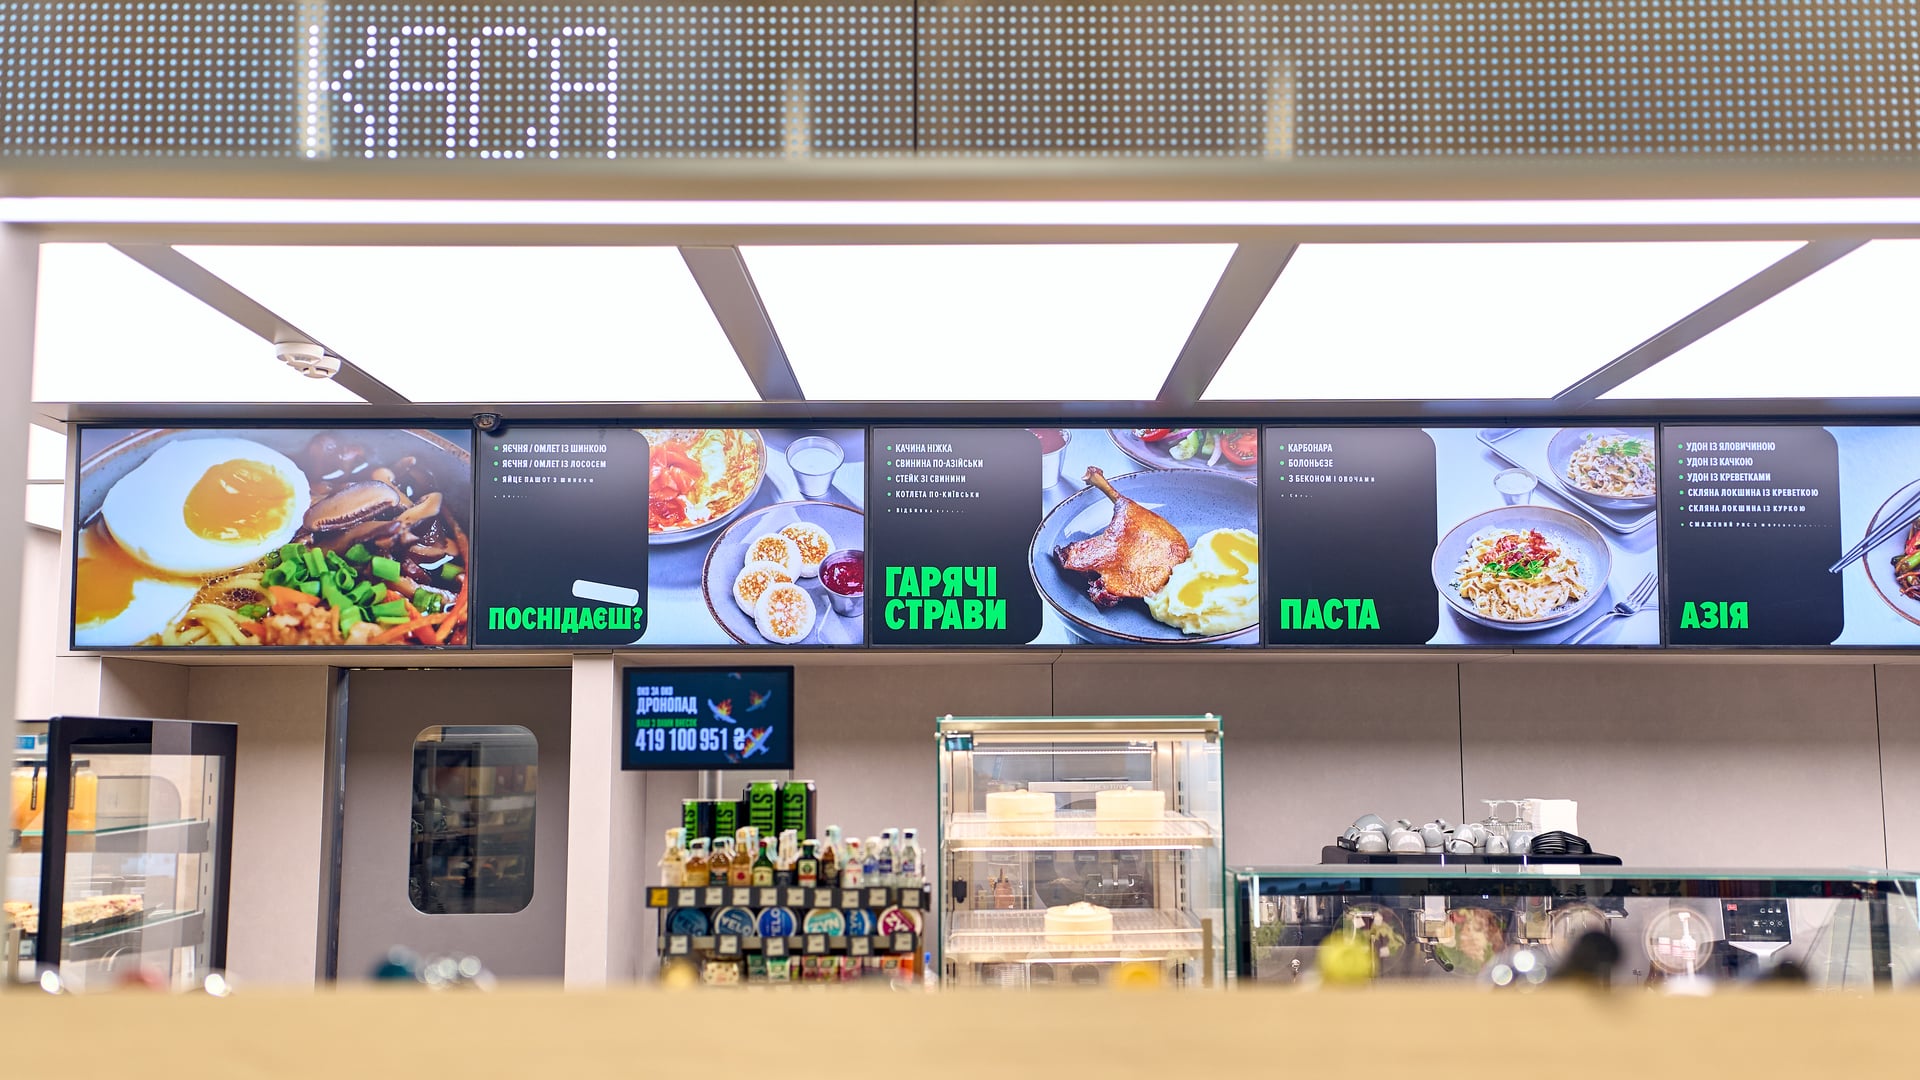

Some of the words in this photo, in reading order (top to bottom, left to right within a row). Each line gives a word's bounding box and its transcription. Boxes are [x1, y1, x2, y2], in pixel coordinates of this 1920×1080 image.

[306, 25, 617, 159] КАСА
[502, 444, 528, 453] ЯЄЧНЯ
[534, 444, 560, 453] ОМЛЕТ
[561, 444, 569, 453] ІЗ
[570, 444, 607, 453] ШИНКОЮ
[895, 444, 926, 453] КАЧИНА
[927, 444, 953, 453] НІЖКА
[1288, 443, 1333, 453] КАРБОНАРА
[1686, 442, 1709, 452] УДОН
[1709, 442, 1718, 451] ІЗ
[1719, 442, 1776, 451] ЯЛОВИЧИНОЮ
[502, 460, 528, 468] ЯЄЧНЯ
[534, 460, 559, 468] ОМЛЕТ
[561, 460, 569, 468] ІЗ
[570, 460, 606, 468] ЛОСОСЕМ
[895, 459, 931, 468] СВИНИНА
[933, 458, 984, 468] ПО-АЗІЙСЬКИ
[1288, 459, 1333, 468] БОЛОНЬЄЗЕ
[1686, 458, 1709, 467] УДОН
[1710, 458, 1718, 466] ІЗ
[1720, 458, 1754, 466] КАЧКОЮ
[502, 475, 523, 484] ЯЙЦЕ
[895, 473, 919, 483] СТЕЙК
[920, 475, 928, 483] ЗІ
[930, 475, 966, 483] СВИНИНИ
[1288, 474, 1294, 483] З
[1295, 474, 1332, 483] БЕКОНОМ
[1333, 475, 1337, 483] І
[1687, 473, 1709, 483] УДОН
[1710, 473, 1718, 481] ІЗ
[1720, 473, 1771, 481] КРЕВЕТКАМИ
[1688, 488, 1720, 497] СКЛЯНА
[1720, 488, 1762, 497] ЛОКШИНА
[1763, 488, 1771, 497] ІЗ
[1772, 488, 1819, 497] КРЕВЕТКОЮ
[885, 566, 997, 597] ГАРЯЧІ
[885, 599, 1007, 630] СТРАВИ
[1281, 598, 1380, 630] ПАСТА
[1680, 601, 1749, 629] АЗІЯ
[488, 606, 643, 634] ПОСНІДАЄШ?
[636, 696, 698, 715] ДРОНОПАД
[635, 728, 665, 751] 419
[668, 728, 697, 751] 100
[700, 728, 728, 751] 951
[722, 916, 752, 936] VELO
